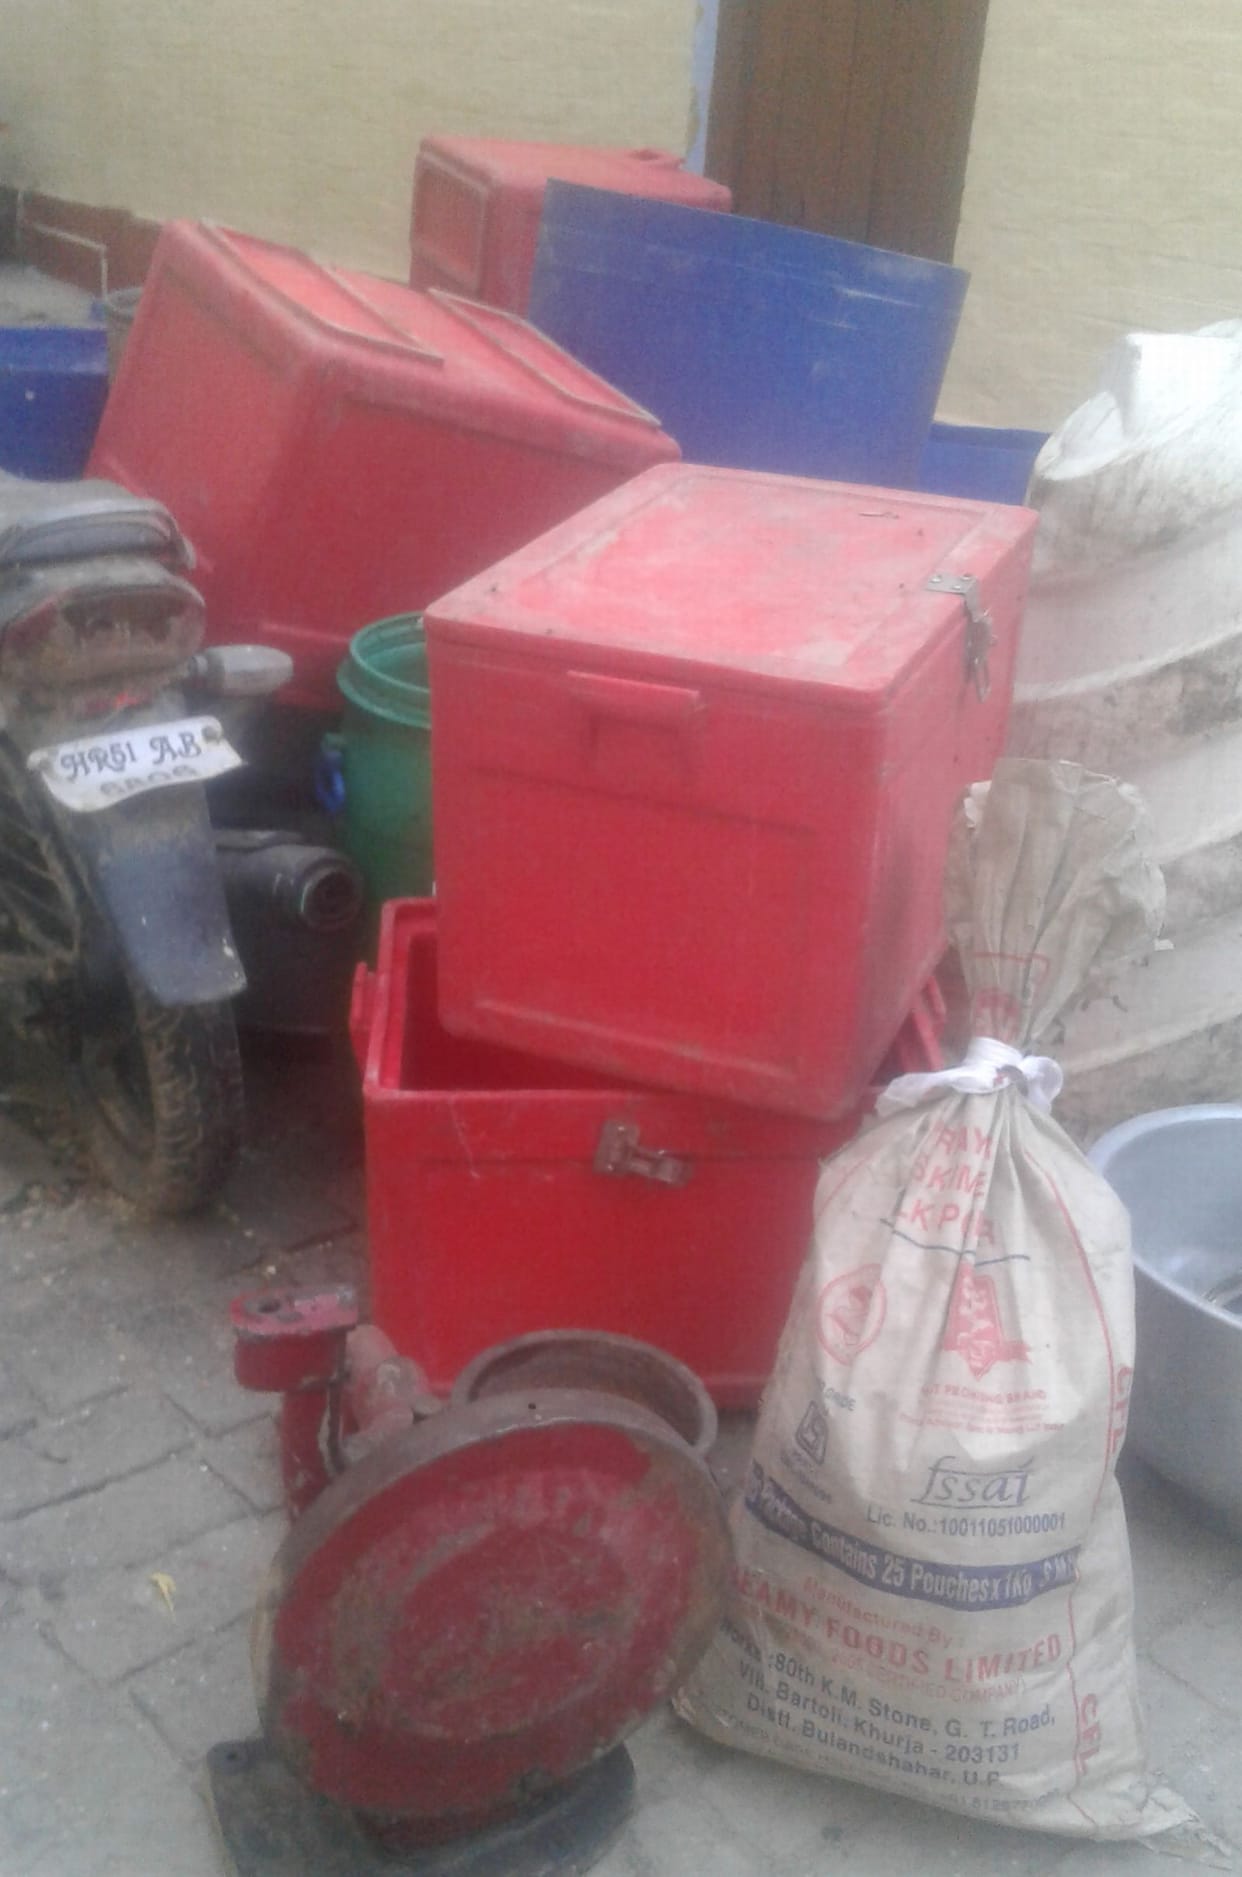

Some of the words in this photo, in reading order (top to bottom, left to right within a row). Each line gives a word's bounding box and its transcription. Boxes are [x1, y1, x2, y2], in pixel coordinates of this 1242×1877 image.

[867, 1503, 897, 1528] Lic.
[810, 1520, 877, 1580] Contains
[881, 1553, 904, 1587] 25
[826, 1616, 929, 1676] FOODS
[944, 1633, 1062, 1683] LIMITED
[1003, 1704, 1056, 1737] Road,
[945, 1743, 1020, 1764] 203131
